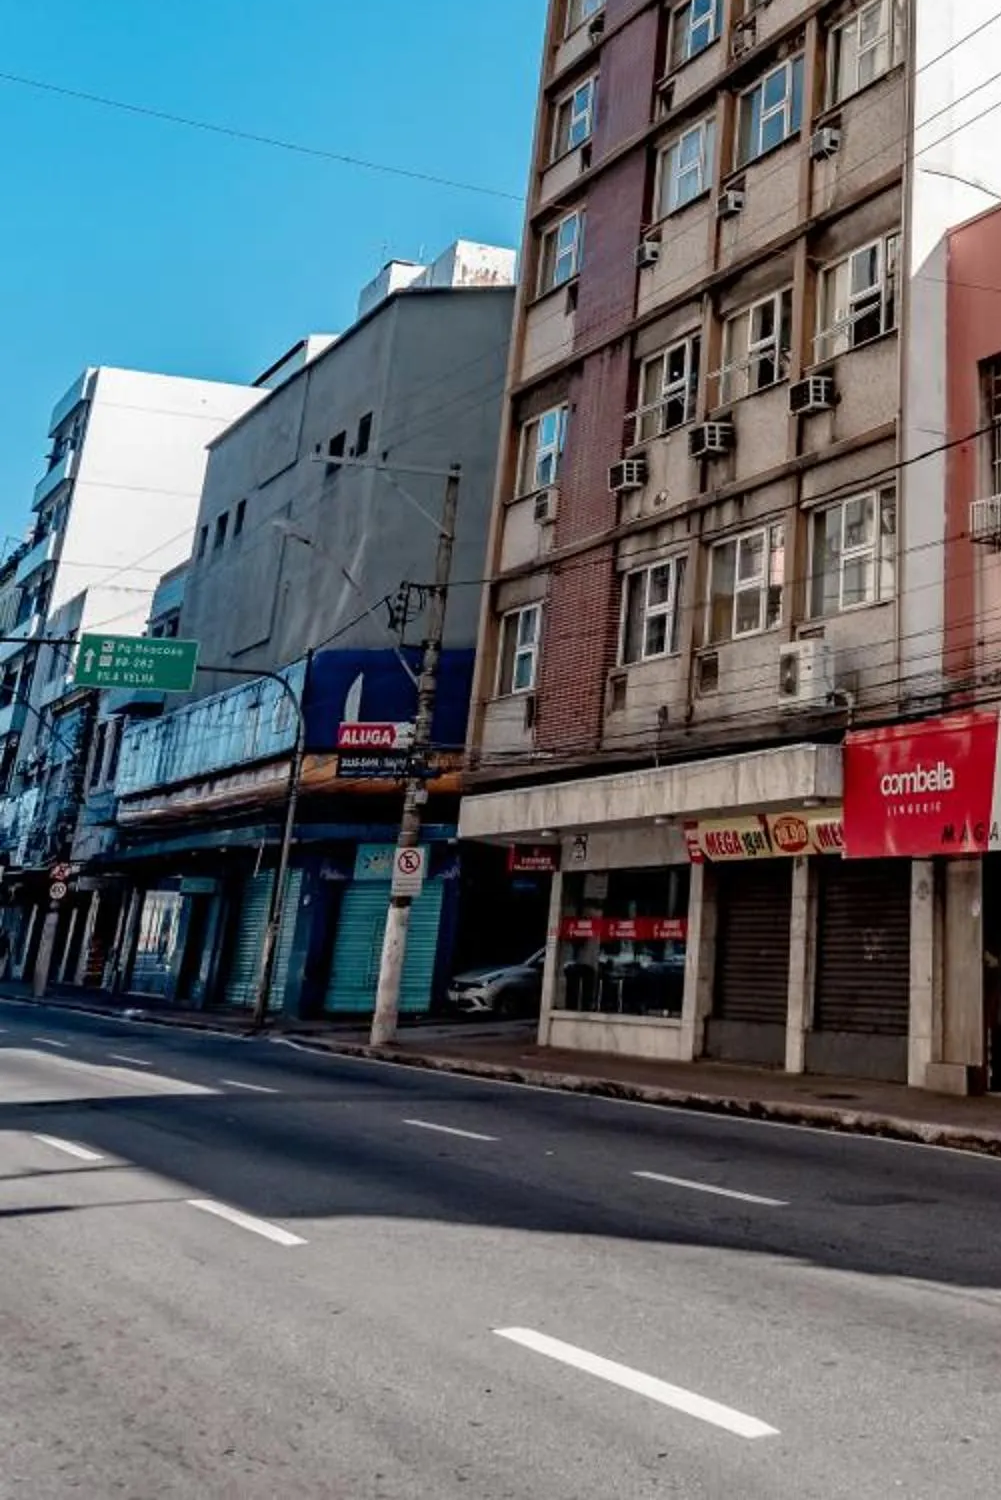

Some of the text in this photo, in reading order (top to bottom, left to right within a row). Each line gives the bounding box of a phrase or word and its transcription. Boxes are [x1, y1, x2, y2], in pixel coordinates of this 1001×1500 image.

[340, 729, 391, 745] ALUGA
[880, 760, 954, 796] combella
[705, 830, 743, 855] MEGA
